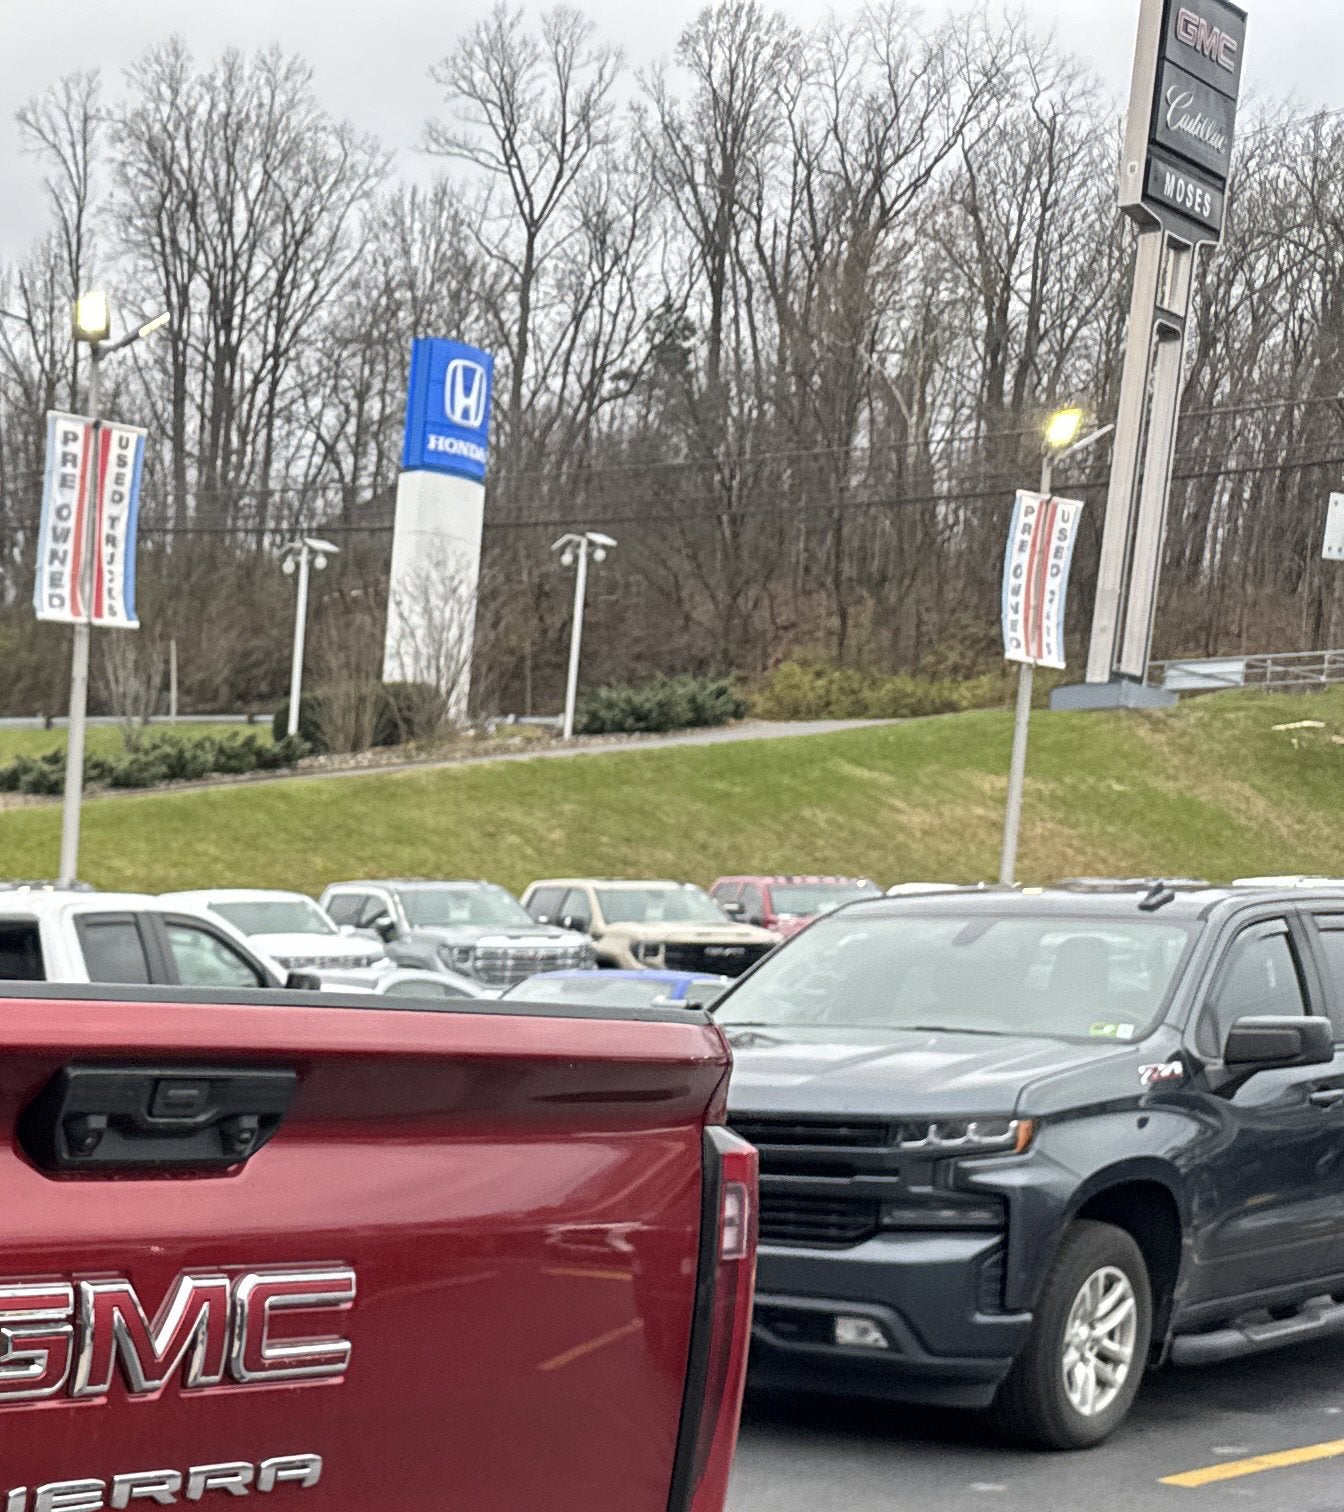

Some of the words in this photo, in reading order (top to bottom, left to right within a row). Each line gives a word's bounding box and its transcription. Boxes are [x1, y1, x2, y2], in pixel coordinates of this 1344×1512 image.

[1176, 7, 1238, 74] GMC
[1164, 171, 1211, 218] MOSES
[59, 430, 79, 489] PRE
[110, 435, 130, 505] USED
[48, 503, 72, 609] OWNED
[1017, 505, 1035, 553] PRE
[1050, 509, 1070, 578] USED
